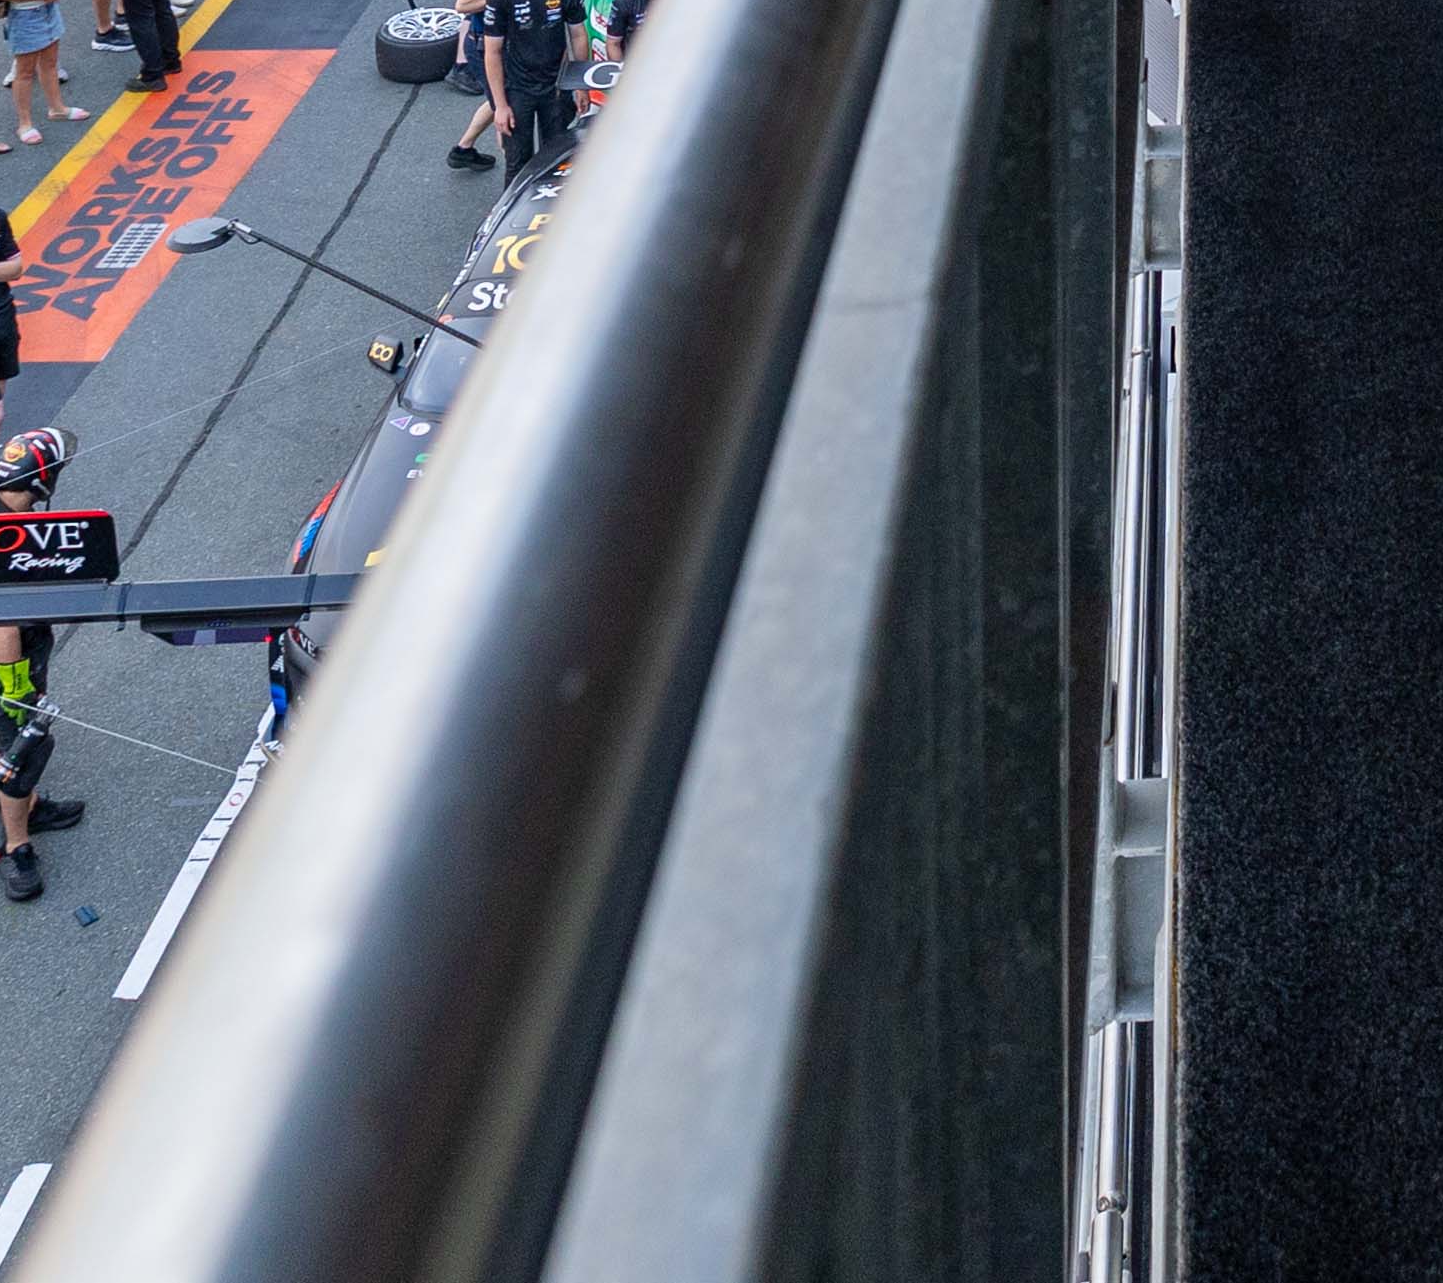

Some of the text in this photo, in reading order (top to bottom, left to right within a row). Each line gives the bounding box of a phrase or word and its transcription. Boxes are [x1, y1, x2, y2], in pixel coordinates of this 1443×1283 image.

[164, 97, 254, 179] OFF
[9, 70, 237, 314] WORKS ITS
[369, 341, 394, 362] 100
[8, 551, 86, 574] Racing
